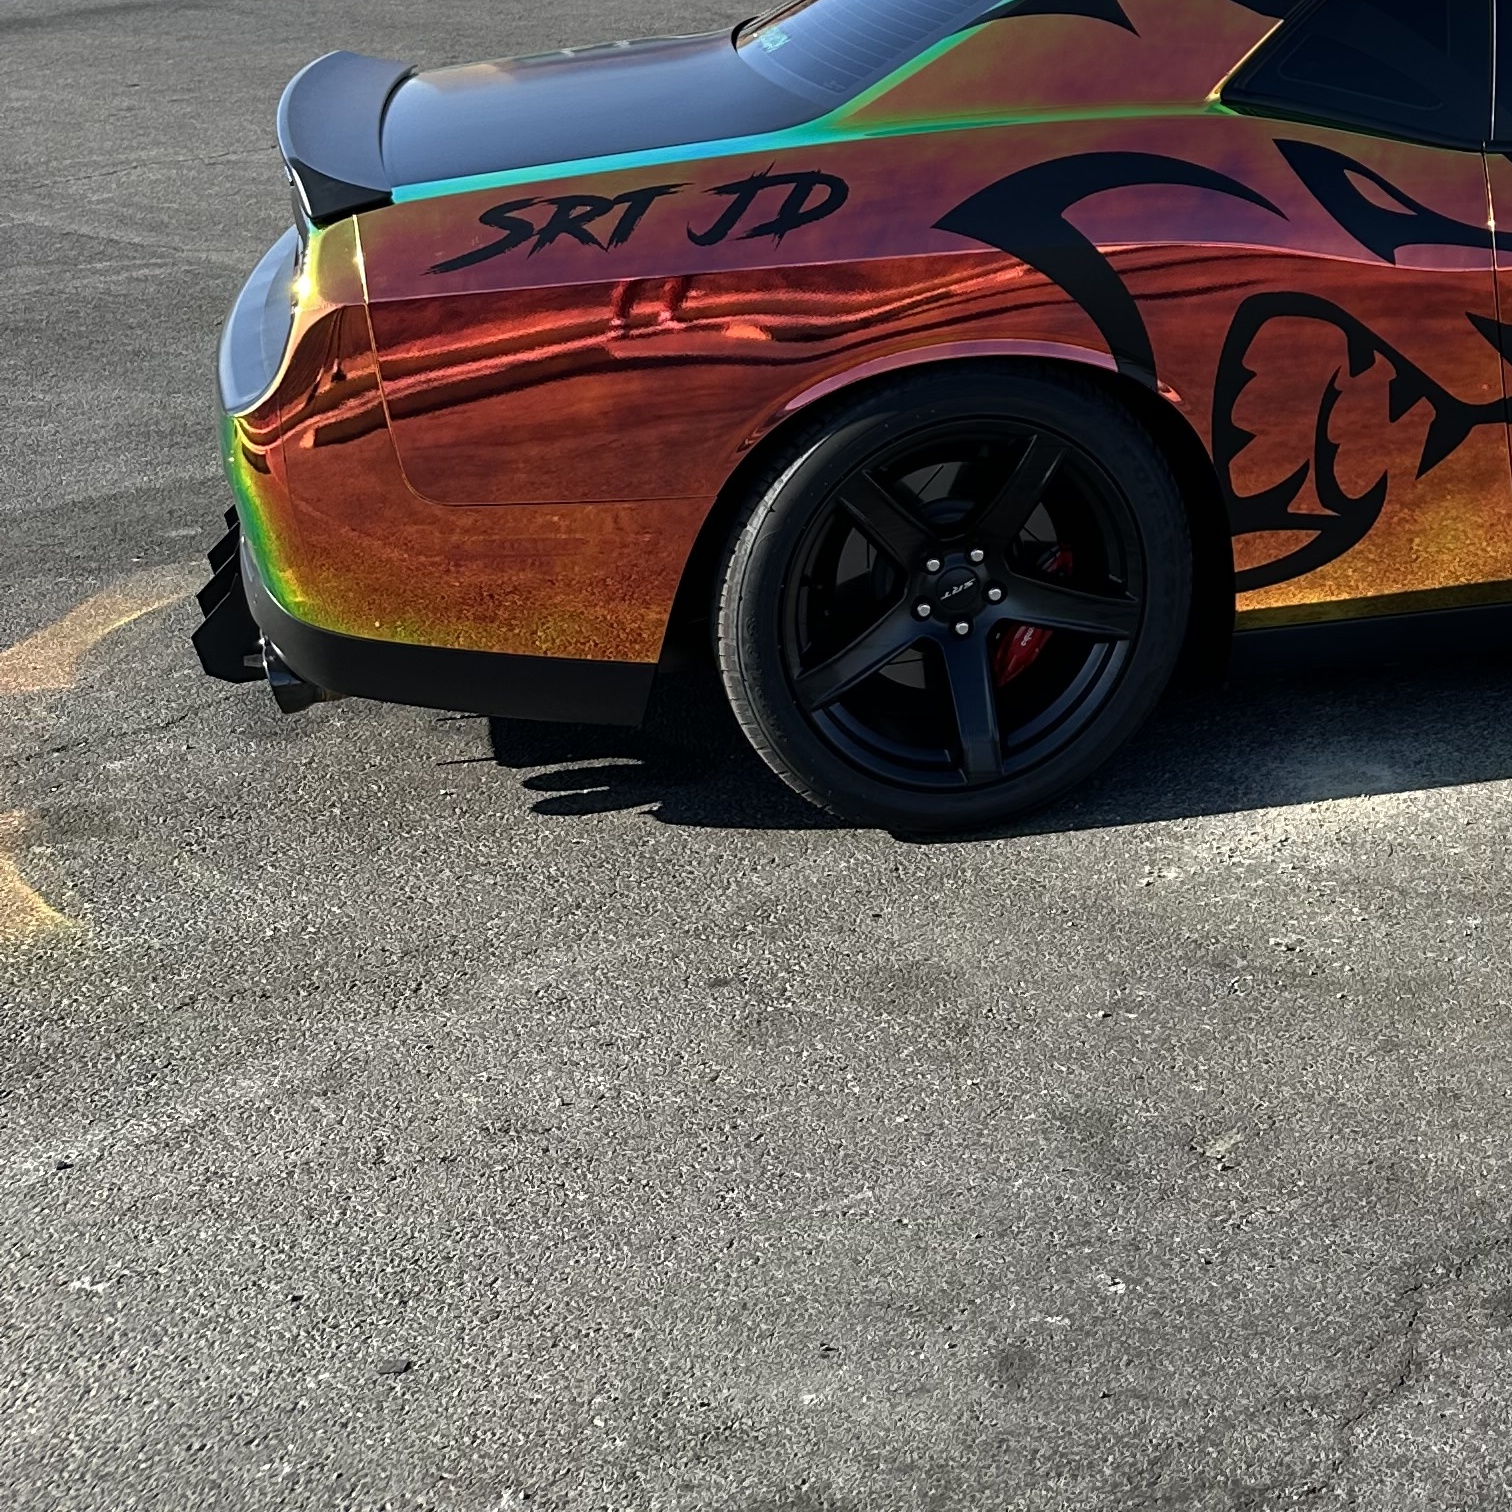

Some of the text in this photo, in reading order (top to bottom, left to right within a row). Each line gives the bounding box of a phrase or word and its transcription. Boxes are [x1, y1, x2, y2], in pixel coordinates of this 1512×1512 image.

[420, 161, 850, 276] SRT JD
[940, 577, 976, 601] SRT
